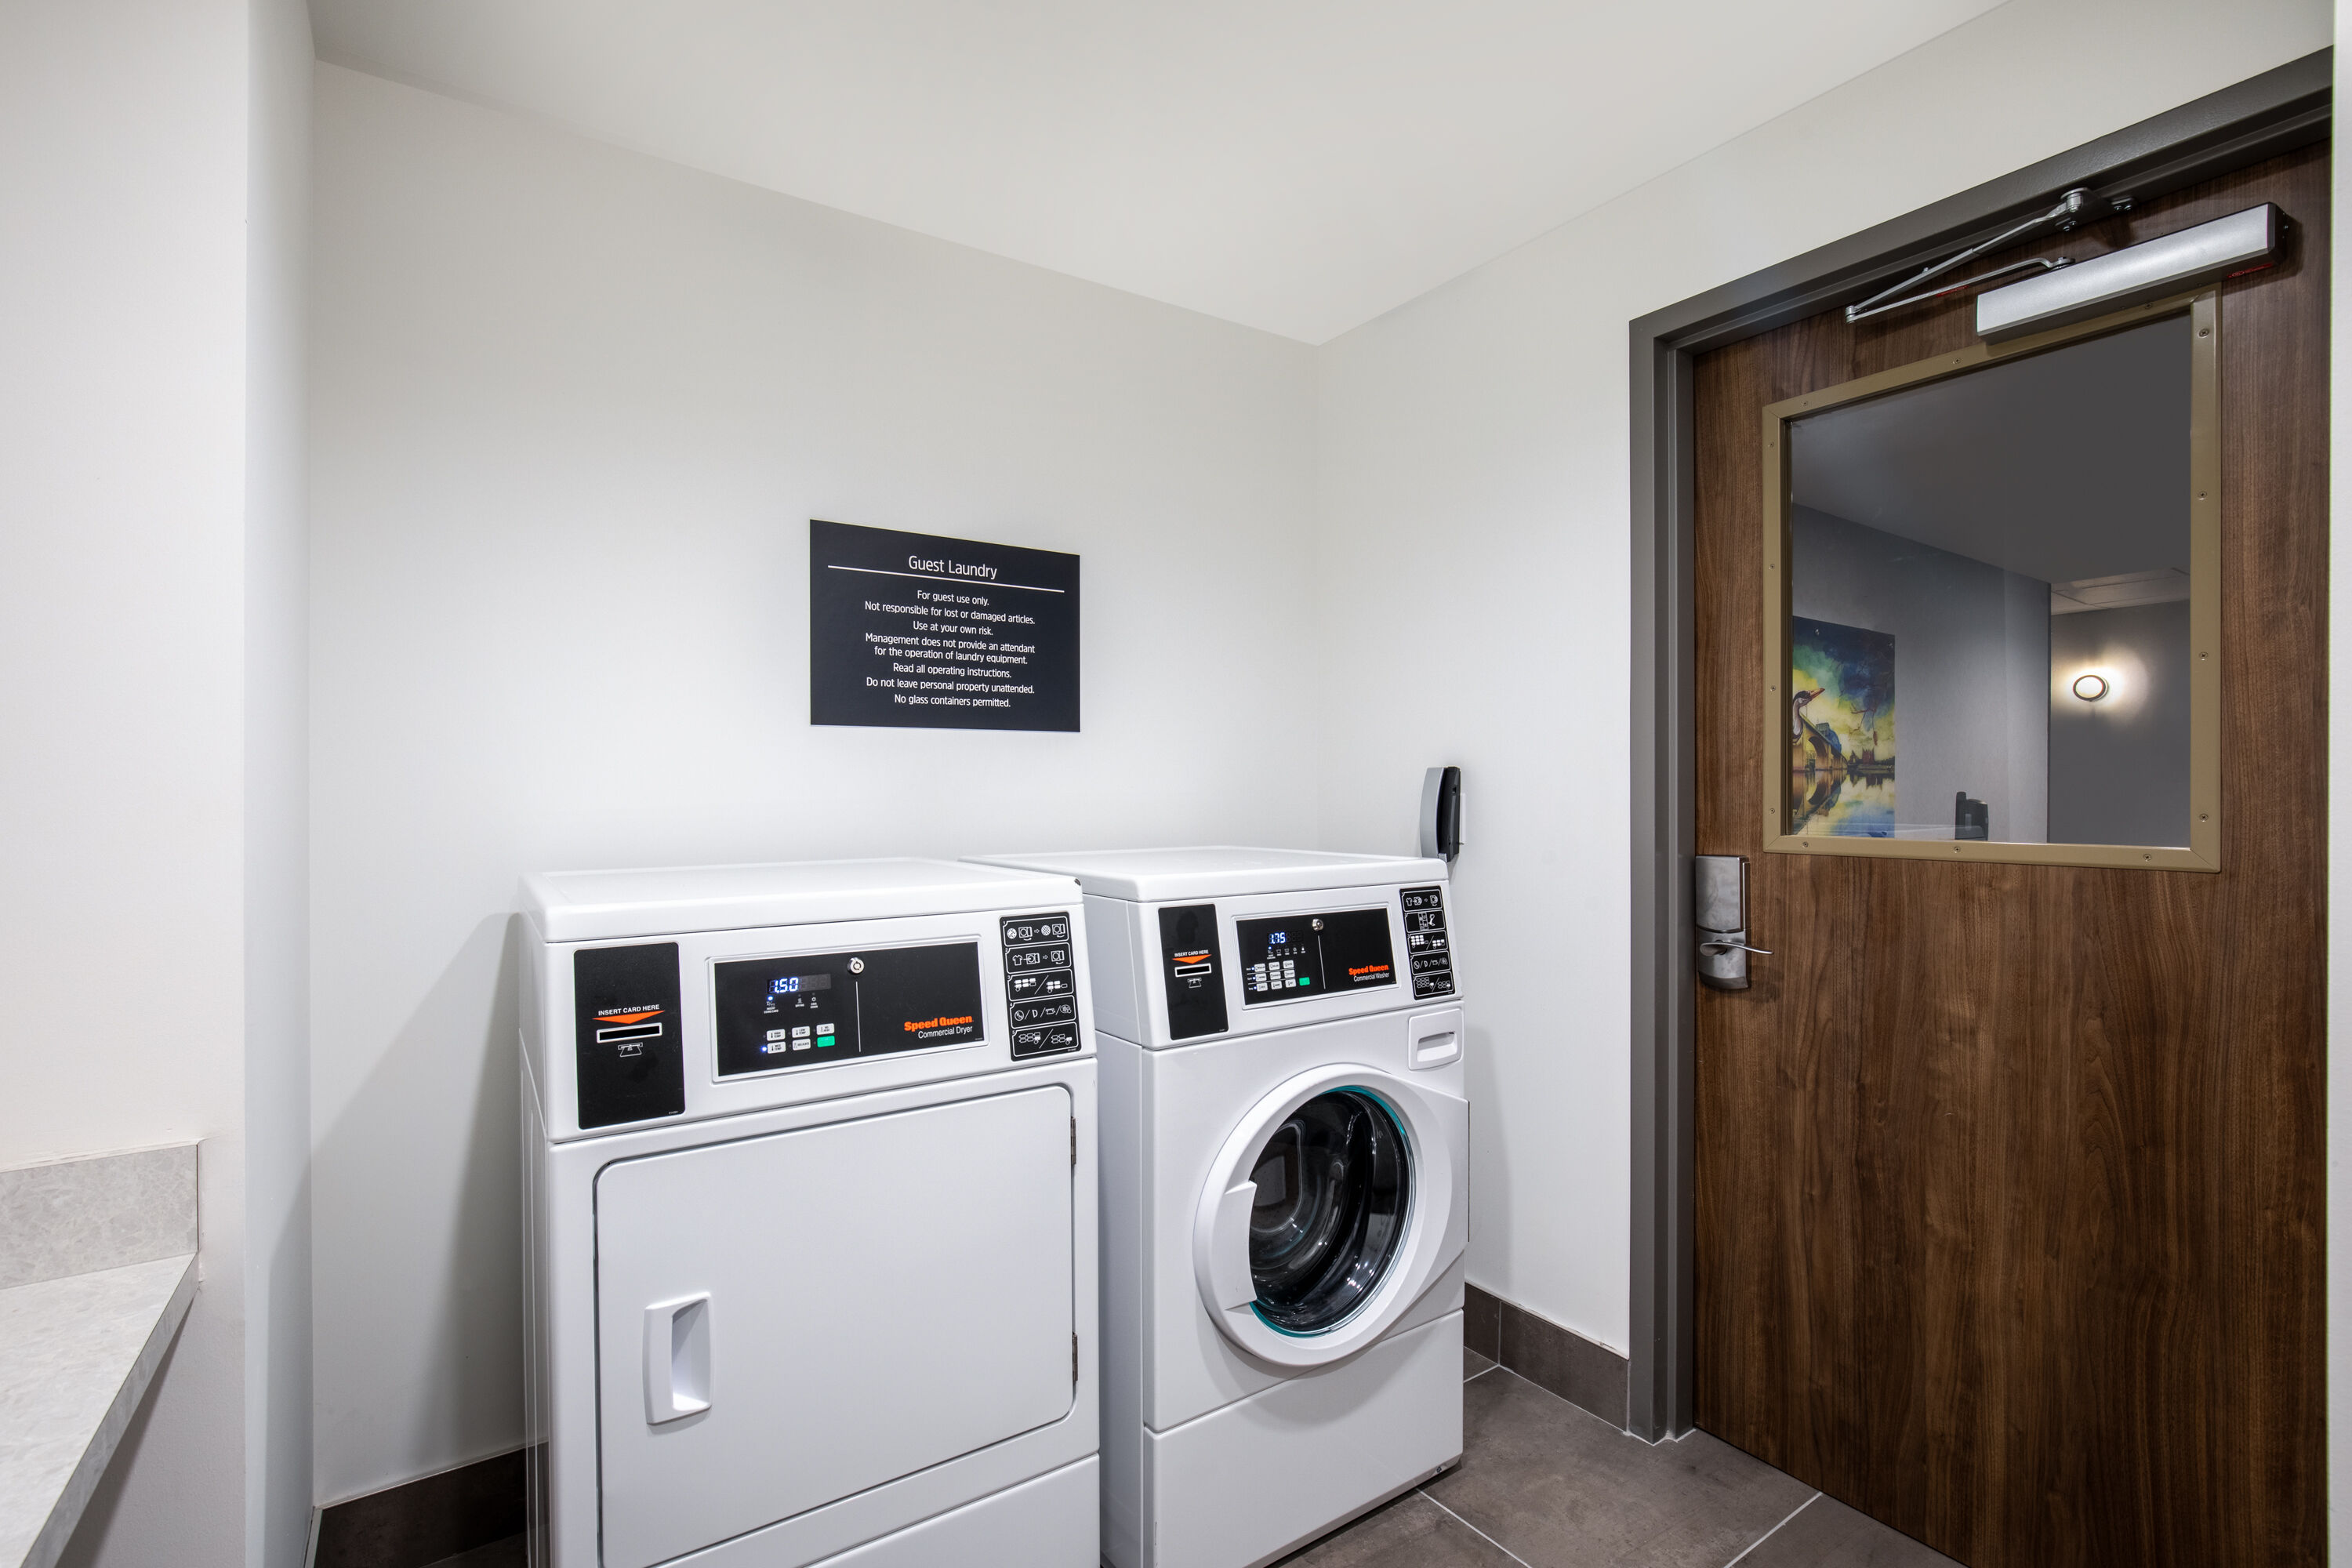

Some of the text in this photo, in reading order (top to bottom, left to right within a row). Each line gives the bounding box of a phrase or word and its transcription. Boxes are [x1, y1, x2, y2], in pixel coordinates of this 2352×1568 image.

[909, 555, 997, 580] Guest Laundry
[917, 590, 931, 600] For
[932, 593, 954, 602] guest
[972, 597, 989, 606] only.
[865, 601, 880, 612] Not
[882, 604, 928, 615] responsible
[931, 607, 942, 616] for
[944, 608, 959, 618] lost
[971, 611, 1006, 622] damaged
[1007, 615, 1035, 624] articles.
[913, 620, 928, 630] Use
[930, 622, 938, 631] at
[960, 626, 977, 634] own
[978, 626, 993, 635] risk.
[866, 633, 920, 645] Management
[921, 637, 941, 647] does
[943, 639, 956, 648] not
[958, 641, 987, 650] provide
[1000, 643, 1035, 653] attendant
[874, 645, 1028, 664] for the operation of laundry equipment.
[893, 662, 1011, 678] Read all operating instructions.
[866, 677, 1035, 694] Do not leave personal property unattended.
[895, 694, 1011, 707] No glass containers permitted.
[1348, 965, 1369, 975] Speed
[1353, 973, 1376, 982] Commercial
[774, 977, 799, 993] 1.50
[904, 1015, 973, 1032] Speed Queen
[918, 1025, 973, 1039] Commercial Dryer
